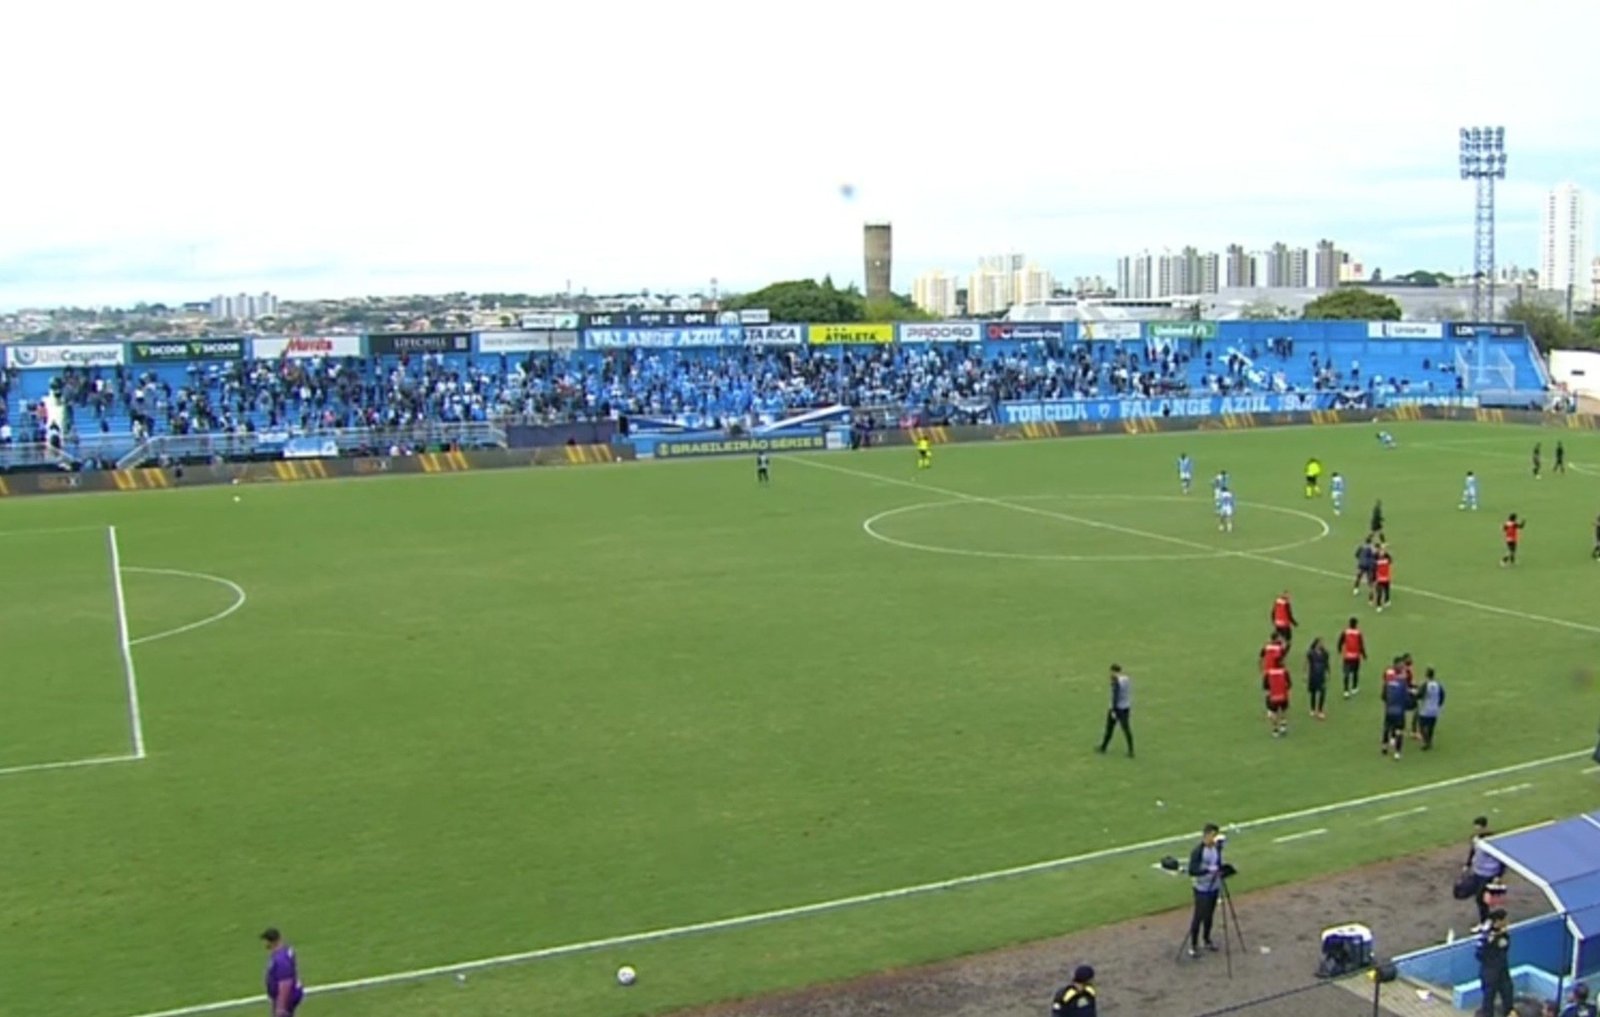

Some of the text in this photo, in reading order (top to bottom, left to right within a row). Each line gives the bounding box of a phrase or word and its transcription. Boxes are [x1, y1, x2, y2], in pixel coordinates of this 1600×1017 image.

[825, 332, 876, 340] ATHLETA
[1005, 401, 1088, 423] TORCIDA
[1119, 397, 1211, 418] FALANGE
[1221, 395, 1271, 414] AZUL
